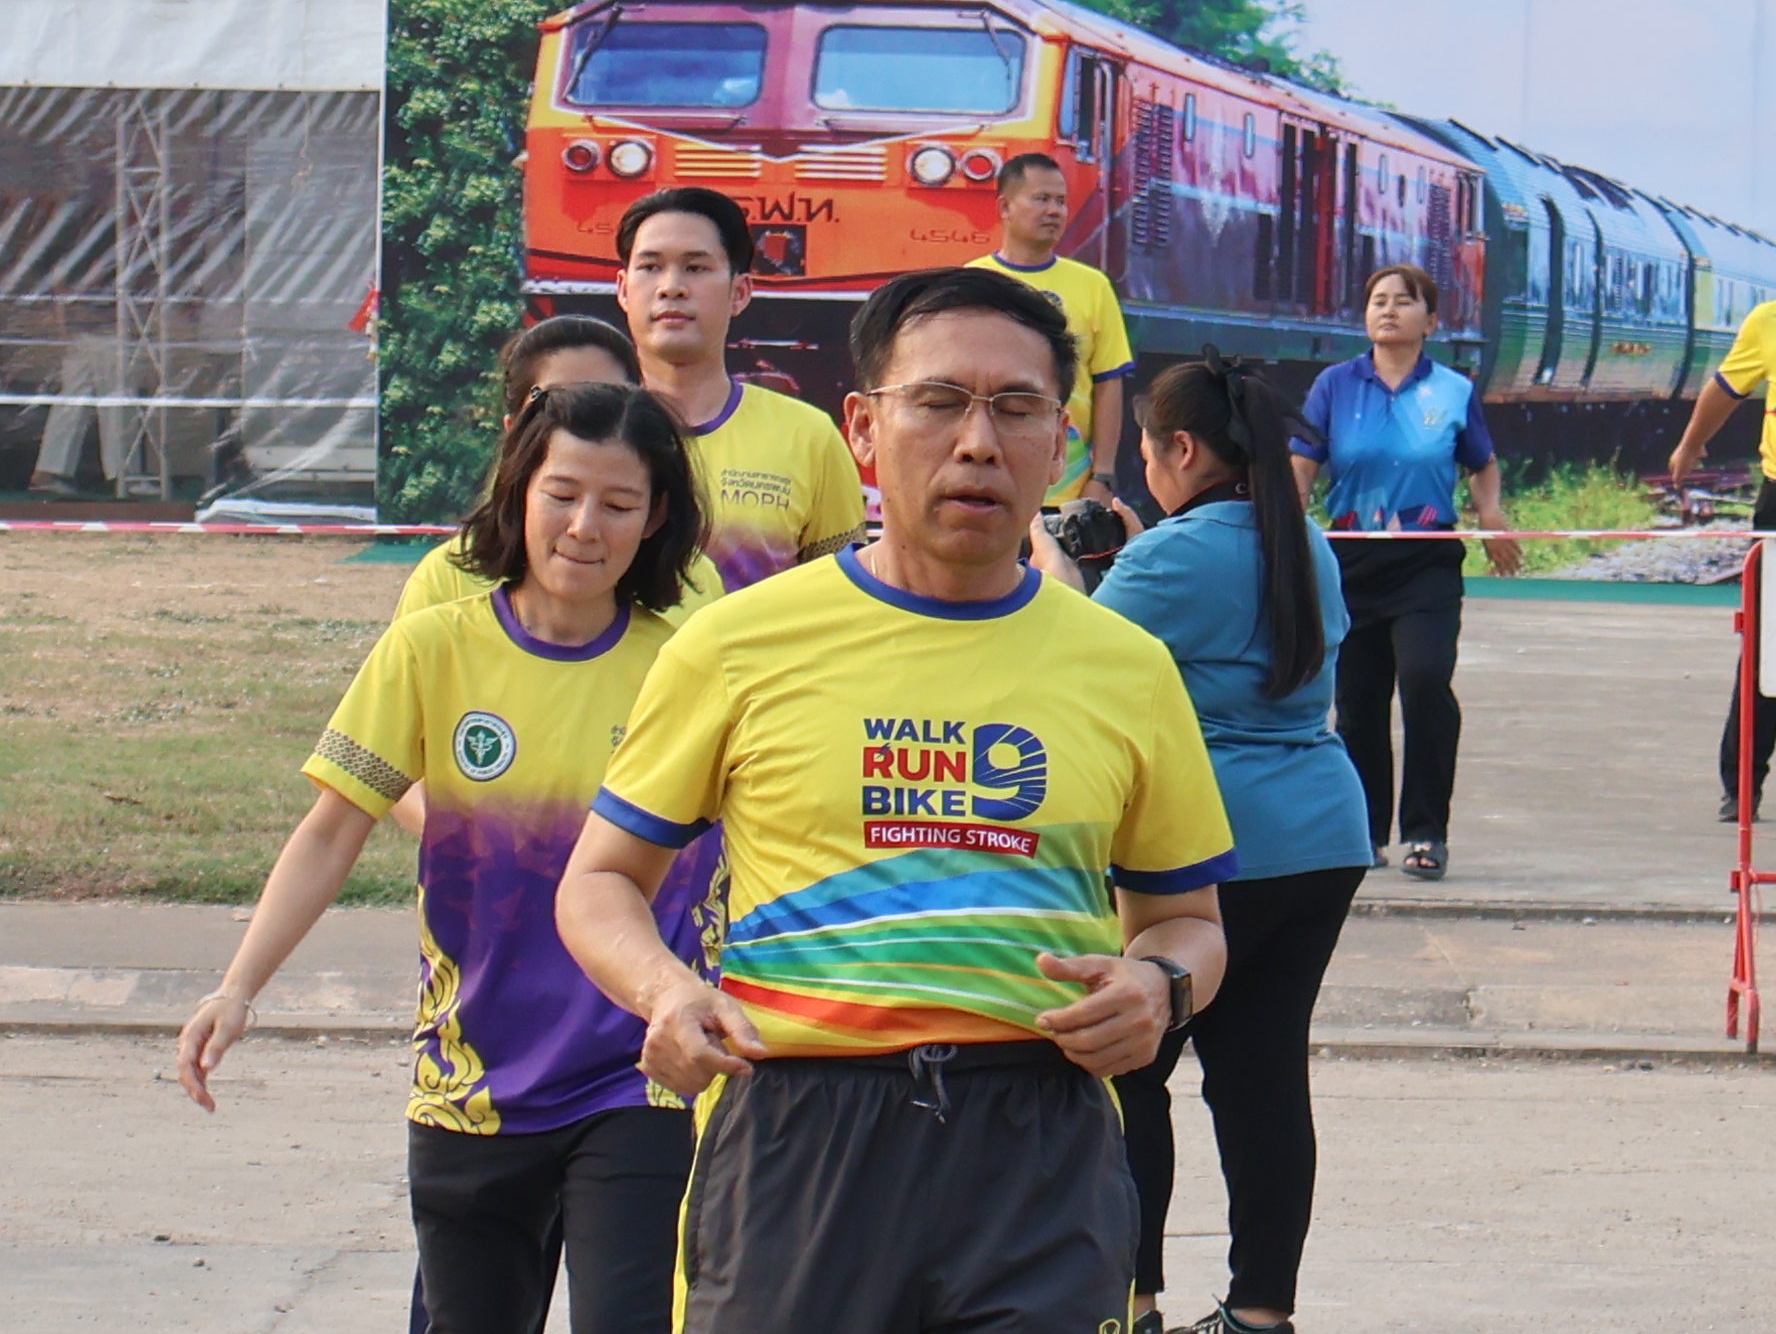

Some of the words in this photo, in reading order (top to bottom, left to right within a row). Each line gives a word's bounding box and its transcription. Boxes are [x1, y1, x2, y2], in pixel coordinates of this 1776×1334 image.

[863, 718, 966, 744] WALK
[862, 745, 966, 783] RUN
[971, 723, 1047, 821] 9
[862, 785, 966, 817] BIKE
[869, 826, 962, 843] FIGHTING
[965, 829, 1033, 853] STROKE
